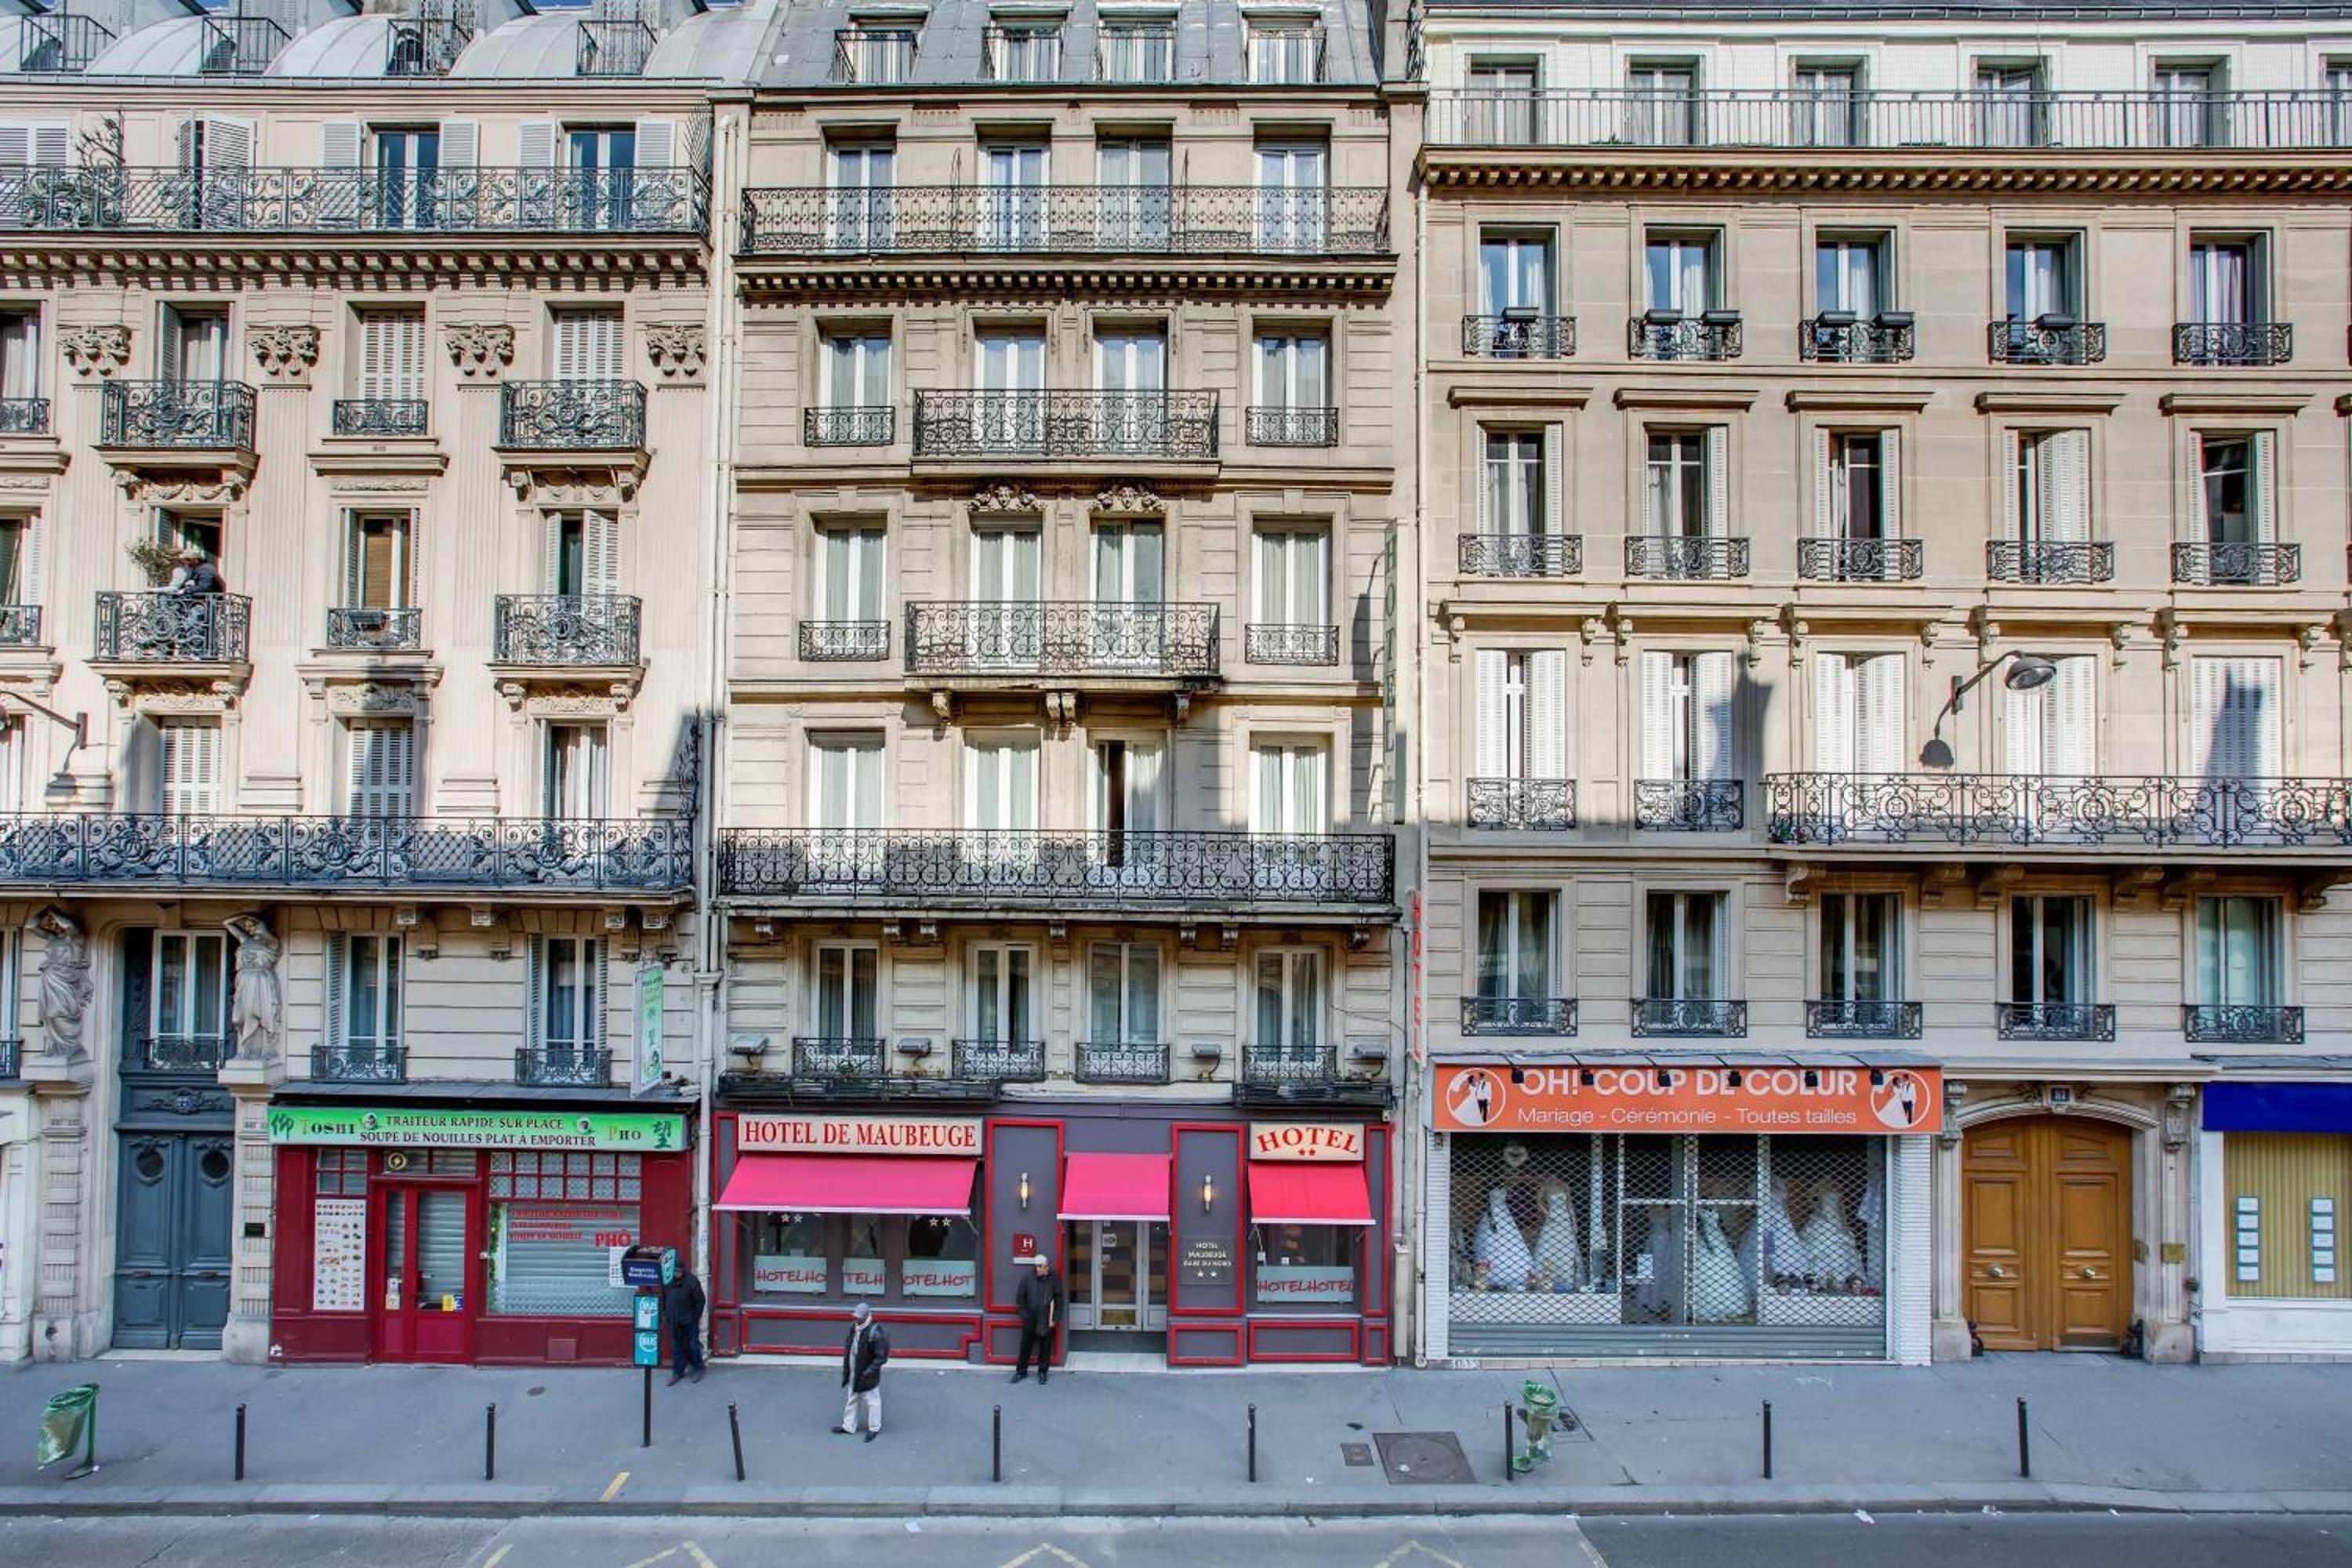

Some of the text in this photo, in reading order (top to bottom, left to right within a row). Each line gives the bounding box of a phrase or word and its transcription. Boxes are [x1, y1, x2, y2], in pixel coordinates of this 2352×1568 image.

[1385, 536, 1396, 753] HOTEL
[1412, 894, 1421, 1062] HOTEL
[1519, 1069, 1578, 1095] OH!
[1593, 1069, 1686, 1095] COUP
[386, 1116, 564, 1130] TRAITEUR RAPIDE SUR PLACE
[1518, 1108, 1594, 1127] Mariage
[1611, 1107, 1716, 1123] Cérémonie
[1737, 1108, 1801, 1123] Toutes
[1806, 1108, 1857, 1123] tailles
[360, 1131, 400, 1142] SOUPE
[403, 1132, 419, 1142] DE
[423, 1132, 482, 1143] NOUILLES
[486, 1134, 514, 1145] PLAT
[531, 1134, 596, 1146] EMPORTER
[746, 1121, 976, 1147] HOTEL DE MAUBEUGE
[1257, 1127, 1359, 1154] HOTEL
[1023, 1238, 1033, 1248] H
